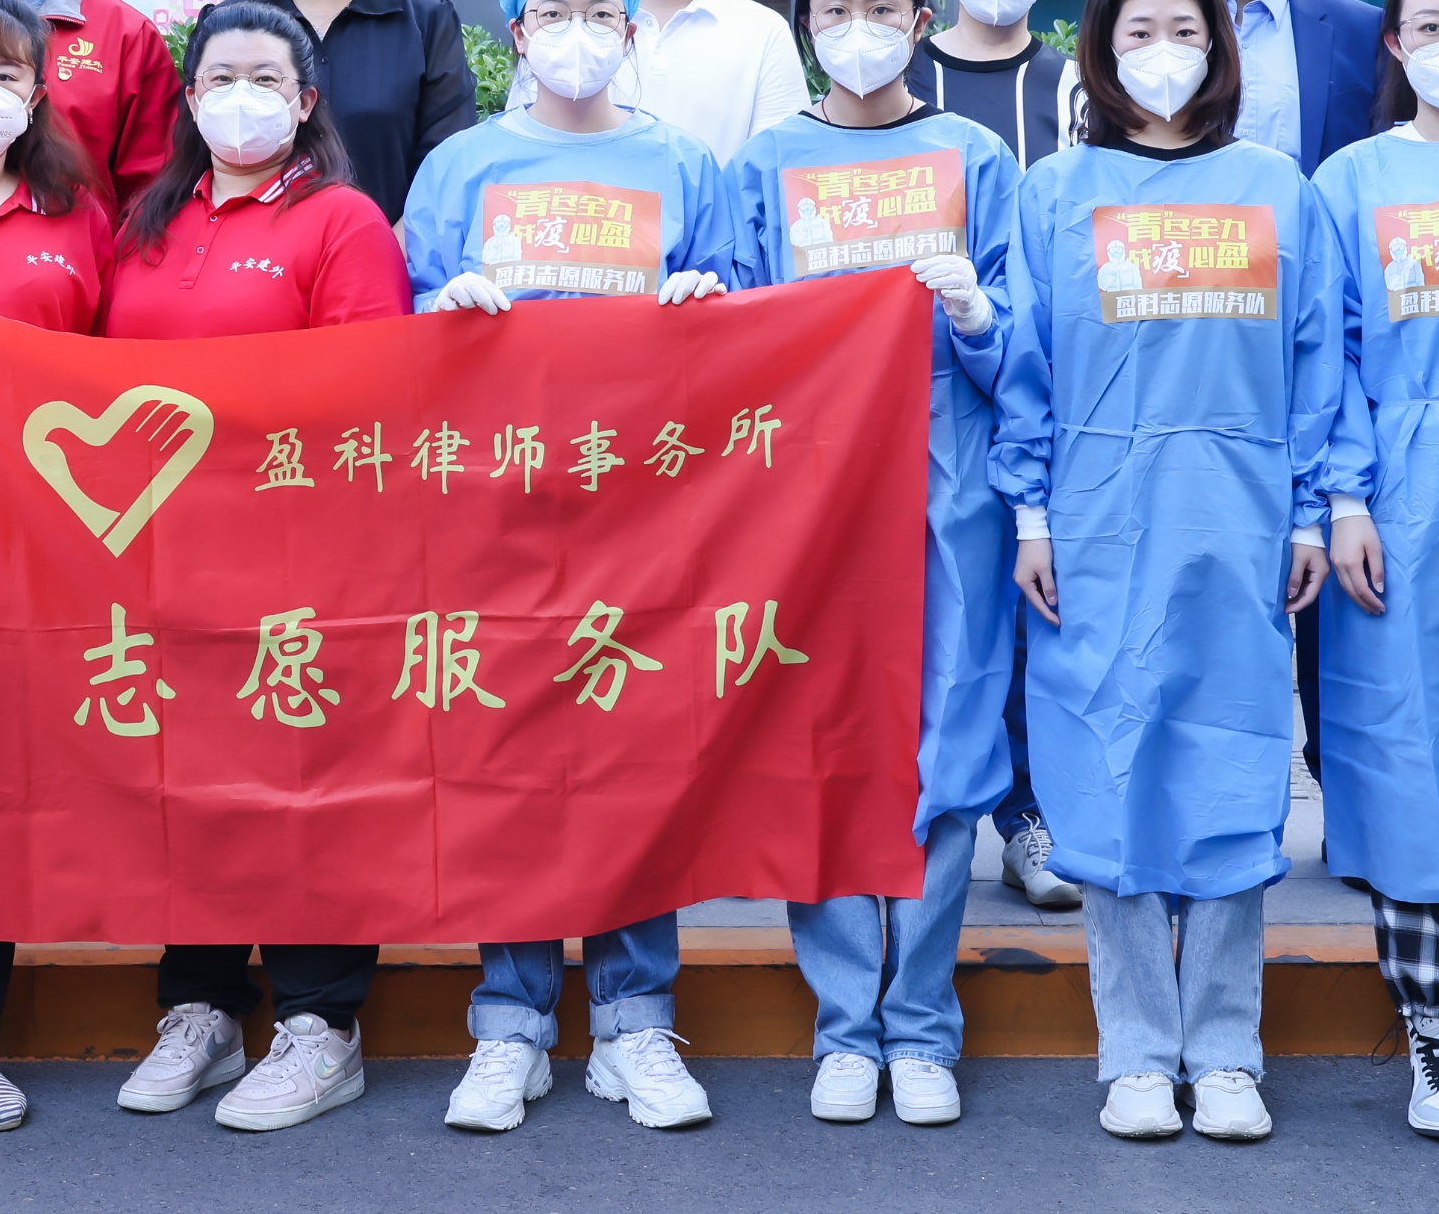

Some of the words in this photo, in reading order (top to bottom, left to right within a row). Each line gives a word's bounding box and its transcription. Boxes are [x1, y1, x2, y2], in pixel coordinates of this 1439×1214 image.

[807, 230, 958, 271] 盈科志愿服务队
[494, 261, 647, 294] 盈科志愿服务队
[1116, 291, 1265, 317] 盈科志愿服务队
[254, 403, 783, 495] 盈科律师事务所
[73, 598, 810, 738] 志愿服务队
